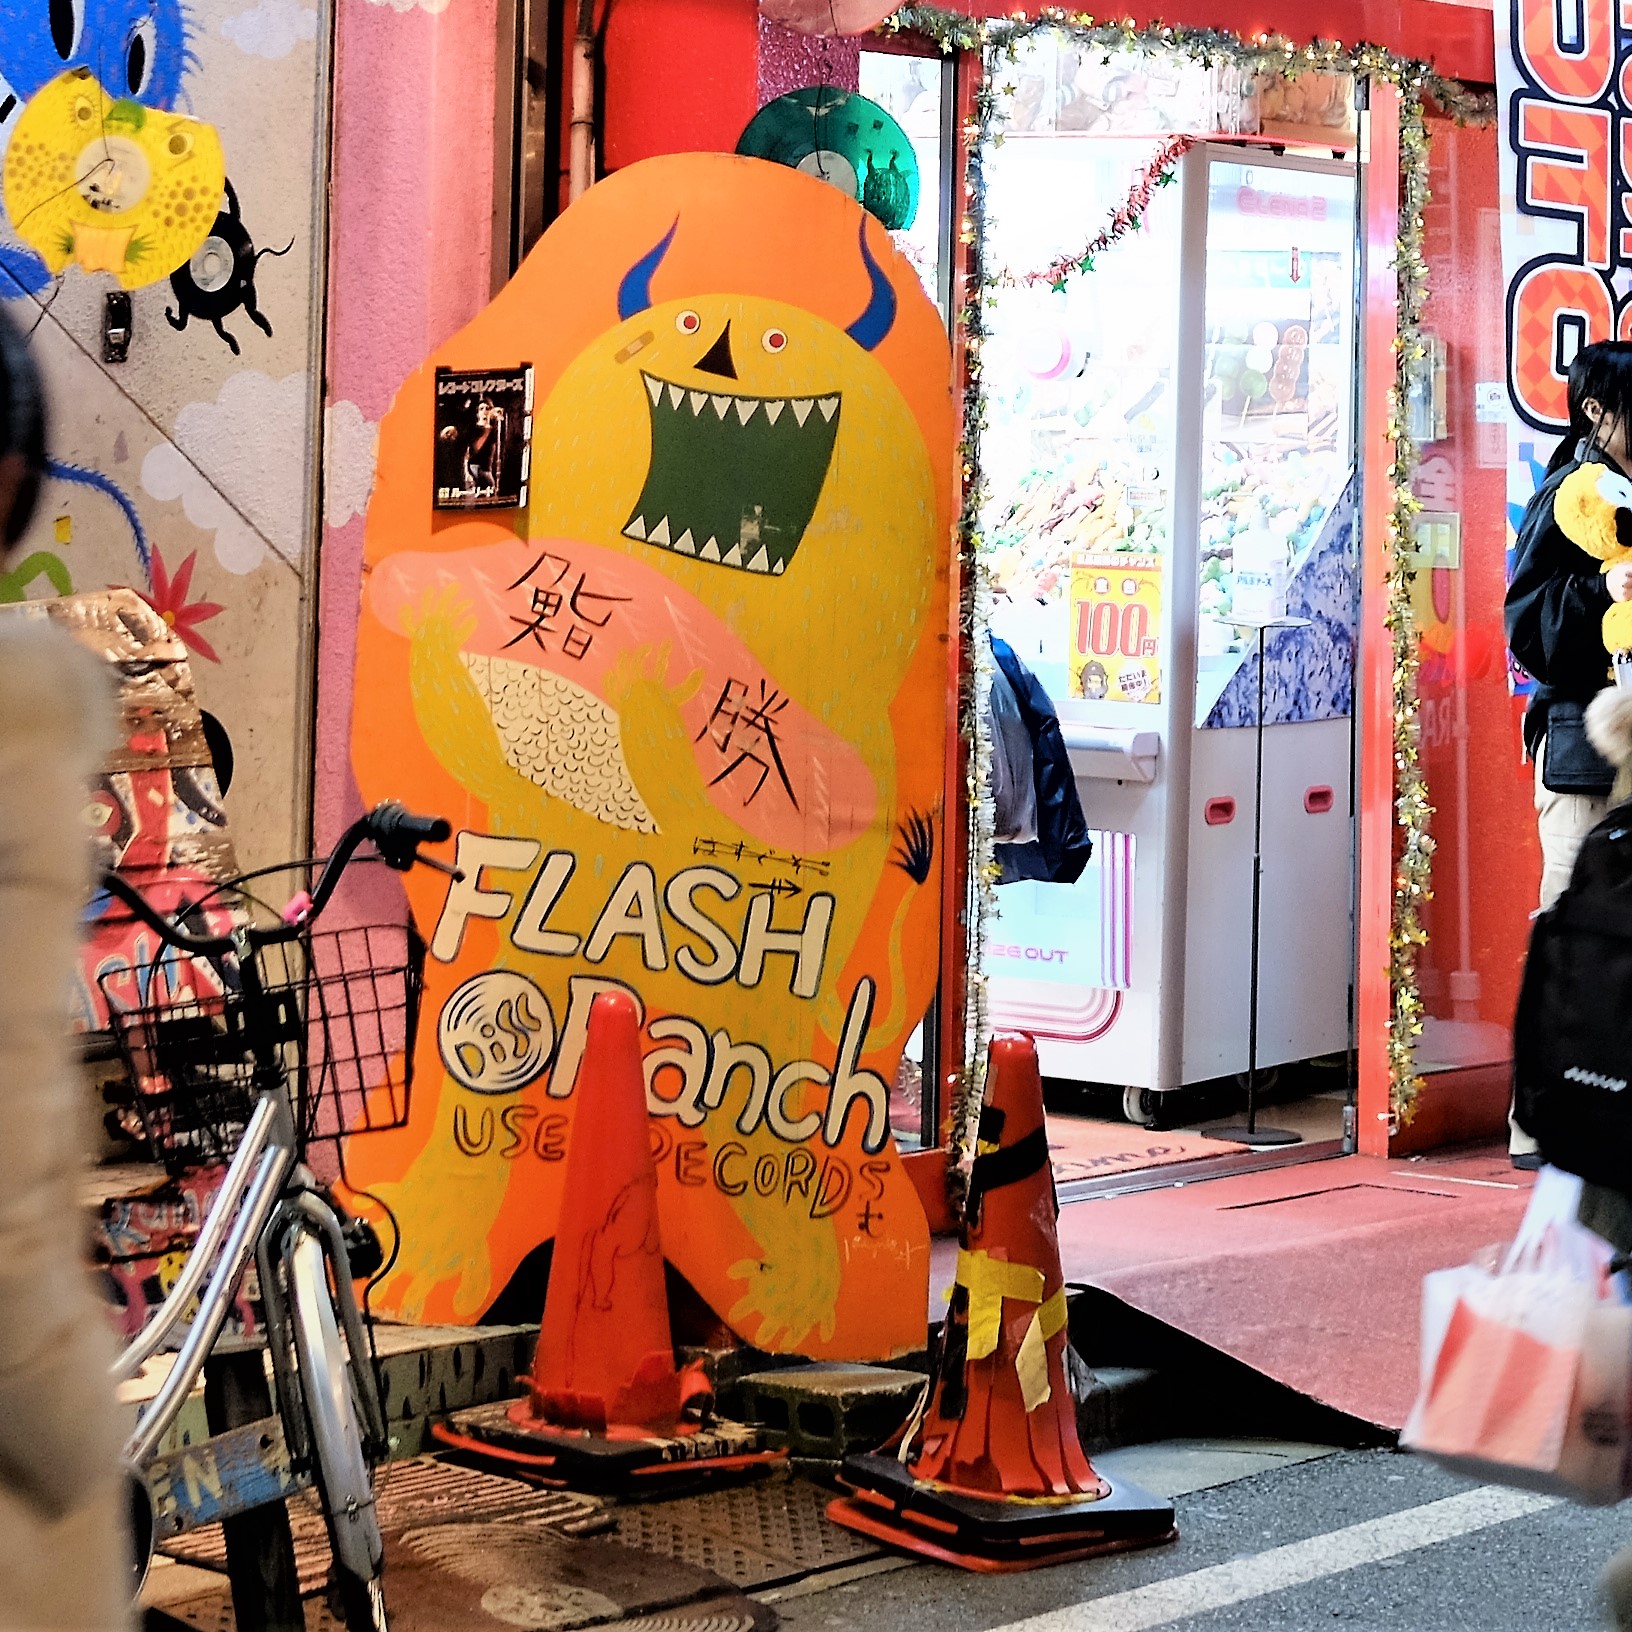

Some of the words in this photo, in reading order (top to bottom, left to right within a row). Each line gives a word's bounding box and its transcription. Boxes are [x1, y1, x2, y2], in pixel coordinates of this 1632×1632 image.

[1076, 601, 1158, 657] 100円
[431, 829, 836, 999] FLASH
[1024, 946, 1070, 964] OUT
[453, 1104, 570, 1161] USE
